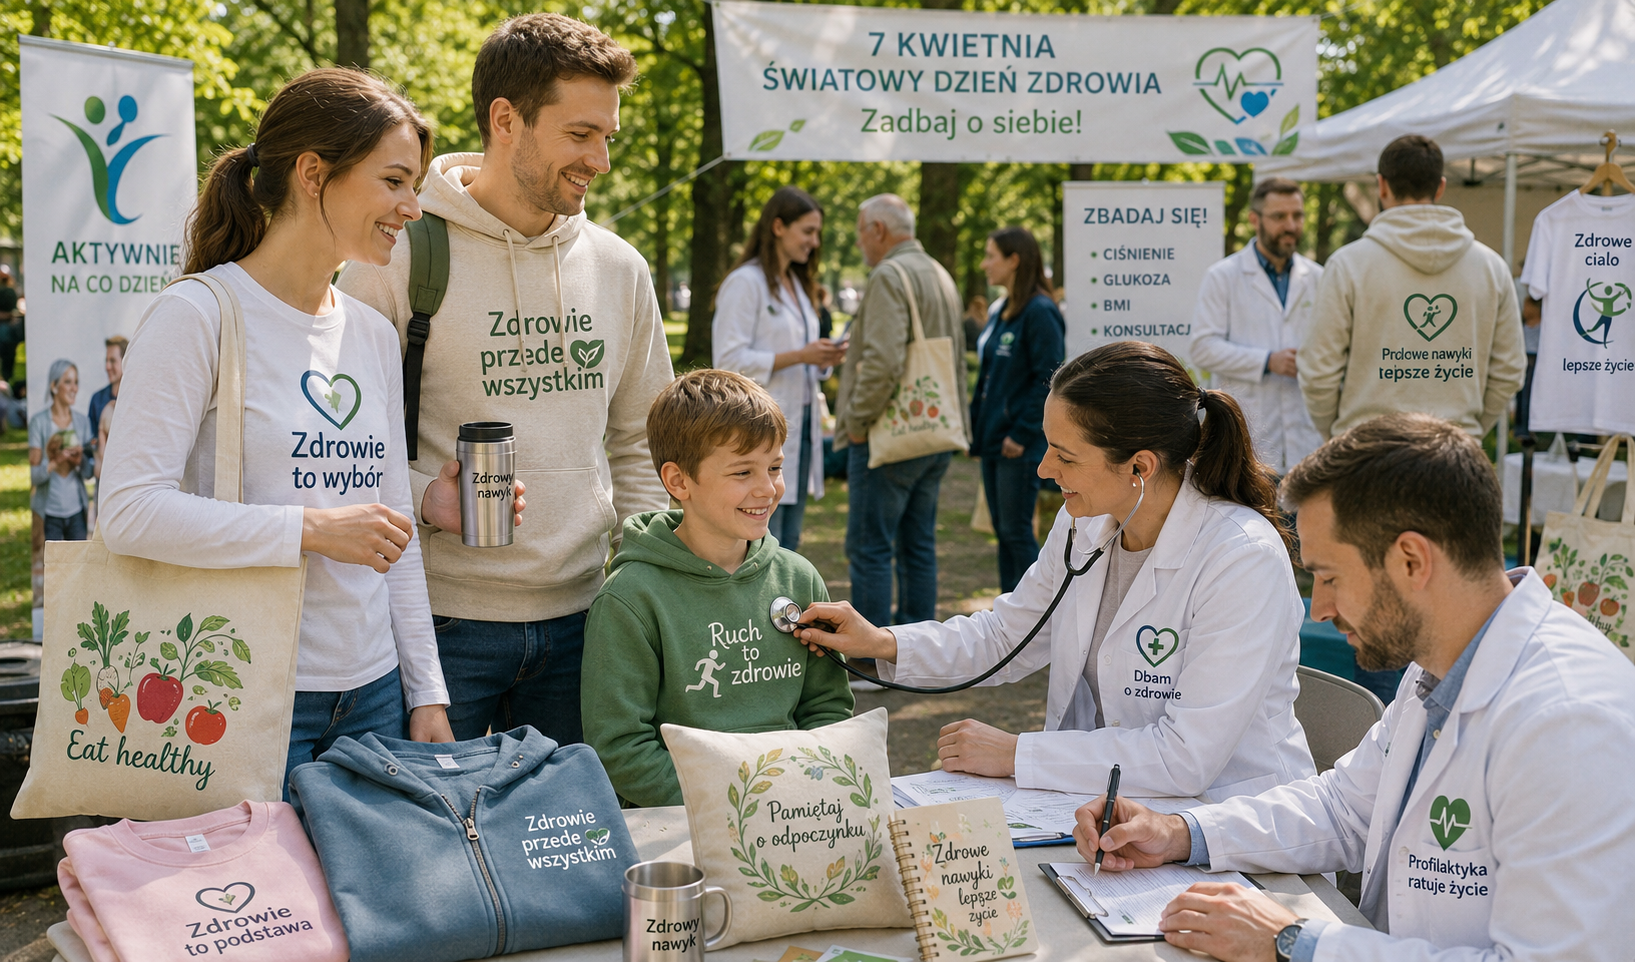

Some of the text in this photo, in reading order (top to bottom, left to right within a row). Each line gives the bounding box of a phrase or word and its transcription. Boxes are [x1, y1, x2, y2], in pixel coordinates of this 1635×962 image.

[868, 32, 1056, 58] 7 KWIETNIA
[763, 61, 1162, 94] ŚWIATOWY DZIEŃ ZDROWIA
[861, 107, 1082, 140] Zadbaj o siebie!
[1083, 207, 1207, 229] ZBADAJ SIĘ!
[1574, 232, 1632, 248] Zdrowe
[51, 241, 180, 266] AKTYWNIE
[1103, 245, 1175, 261] CIŚNIENIE
[1585, 251, 1620, 267] cialo
[52, 275, 80, 293] NA
[86, 275, 113, 293] CO
[1103, 273, 1171, 287] GLUKOZA
[1103, 299, 1131, 311] BMI
[488, 308, 593, 337] Zdrowie
[1103, 324, 1191, 337] KONSULTACJ
[480, 339, 564, 376] przede
[1431, 346, 1472, 363] nawyki
[1563, 358, 1635, 375] lepsze życie
[482, 367, 604, 401] wszystkim
[1434, 363, 1474, 383] życie
[291, 431, 385, 459] Zdrowie
[292, 464, 384, 496] to wybór
[472, 471, 514, 486] Zdrowy
[477, 485, 512, 502] nawyk
[708, 618, 763, 650] Ruch
[741, 645, 760, 661] to
[731, 657, 802, 686] zdrowie
[1134, 669, 1171, 685] Dbam
[1124, 685, 1182, 700] o zdrowie
[66, 729, 216, 791] Eat healthy
[524, 809, 596, 832] Zdrowie
[766, 798, 844, 824] Pamiętaj
[521, 829, 582, 857] przede
[756, 818, 867, 853] o odpoczynku
[527, 845, 617, 871] wszystkim
[931, 841, 990, 865] Zdrowe
[941, 860, 994, 891] nawyki
[1408, 853, 1488, 880] Profilaktyka
[1408, 877, 1489, 900] ratuje życie
[185, 906, 293, 939] Zdrowie
[646, 917, 700, 934] Zdrowy
[184, 920, 314, 957] to podstawa
[652, 933, 697, 953] nawyk
